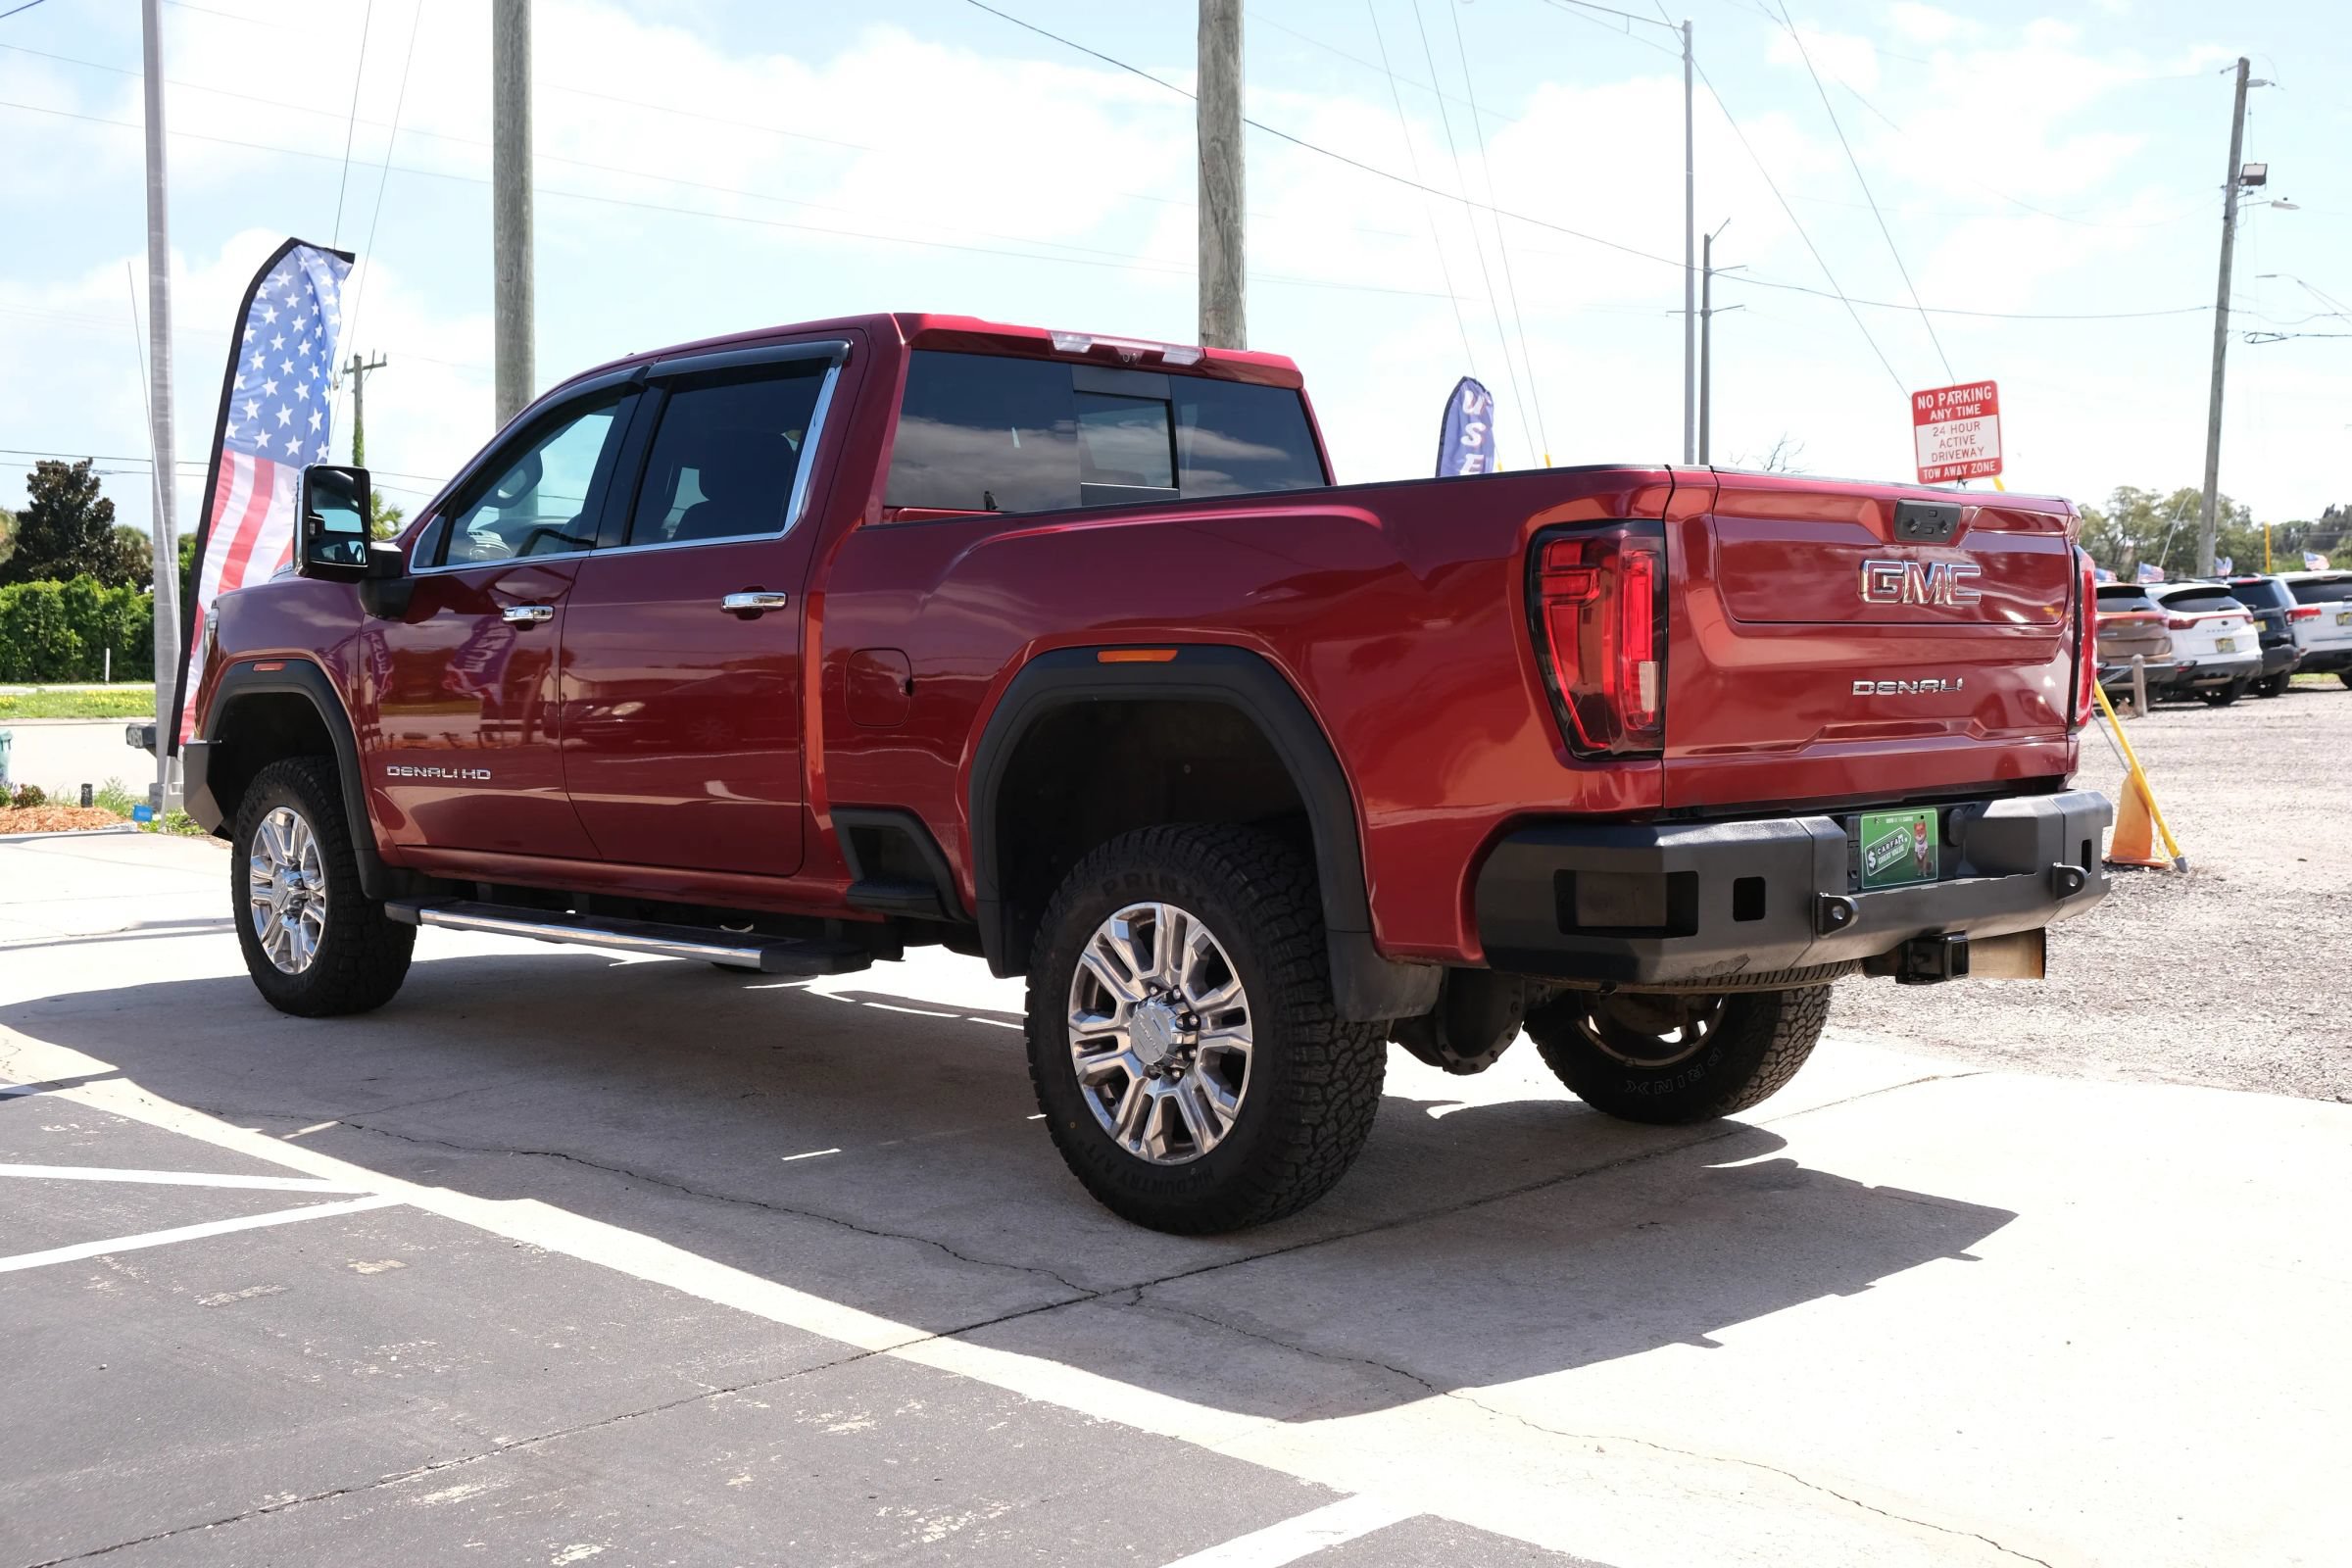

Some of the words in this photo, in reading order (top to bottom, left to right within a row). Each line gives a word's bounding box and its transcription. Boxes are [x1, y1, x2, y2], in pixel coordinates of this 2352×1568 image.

[1917, 395, 1934, 410] NO
[1938, 386, 1992, 406] PARKING
[1930, 408, 1952, 421] ANY
[1956, 404, 1981, 416] TIME
[1933, 426, 1945, 437] 24
[1951, 421, 1981, 434] HOUR
[1939, 435, 1976, 449] ACTIVE
[1931, 447, 1984, 463] DRIVEWAY
[1923, 467, 1941, 479] TOW
[1944, 465, 1968, 477] AWAY
[1971, 461, 1995, 474] ZONE
[1859, 560, 1982, 605] GMC
[1852, 677, 1963, 696] DENALI
[386, 765, 458, 778] DENALI
[462, 768, 491, 780] HD
